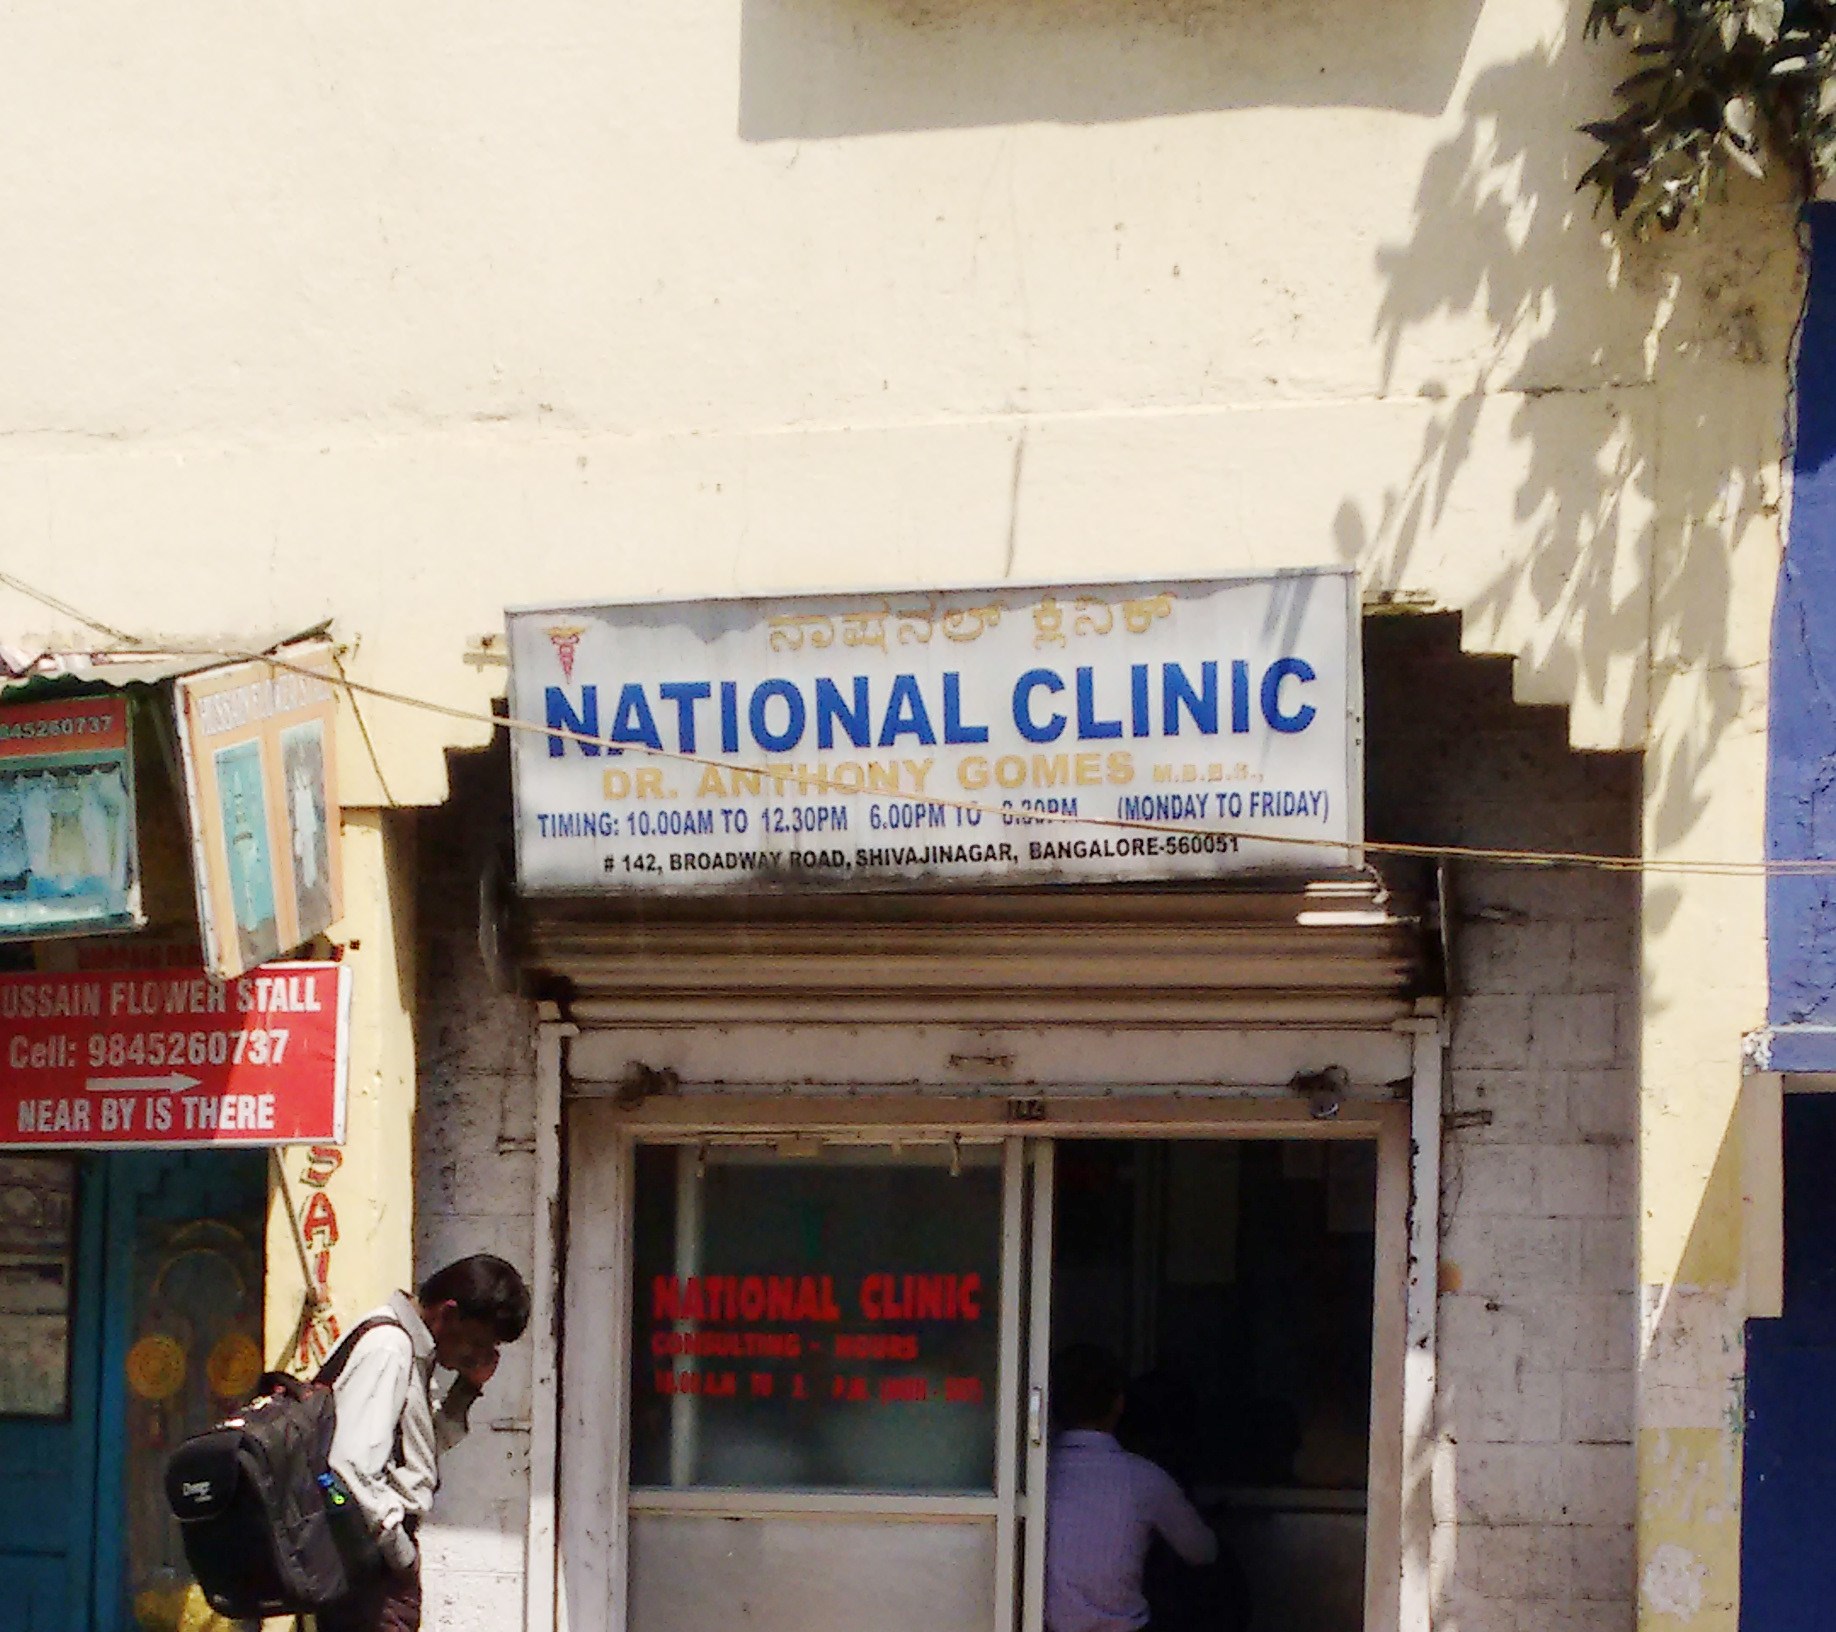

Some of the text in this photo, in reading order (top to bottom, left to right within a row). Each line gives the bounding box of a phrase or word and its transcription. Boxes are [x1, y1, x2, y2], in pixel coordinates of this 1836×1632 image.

[545, 656, 1318, 759] NATIONAL CLINIC
[602, 766, 679, 801] DR.
[698, 757, 936, 798] ANTHONY
[957, 751, 1136, 791] GOMES
[536, 810, 620, 838] TIMING:
[627, 808, 714, 837] 10.00AM
[720, 807, 749, 835] TO
[761, 804, 848, 833] 12.30PM
[869, 801, 947, 831] 6.00PM
[955, 799, 982, 828] TO
[1117, 791, 1207, 823] (MONDAY
[1216, 789, 1243, 818] TO
[1249, 788, 1330, 824] FRIDAY)
[622, 852, 664, 875] 142,
[669, 849, 783, 872] BROADWAY
[789, 847, 852, 871] ROAD,
[855, 842, 1020, 868] SHIVAJINAGAR,
[1028, 836, 1241, 861] BANGALORE-560051
[109, 977, 227, 1016] FLOWER
[236, 976, 322, 1014] STALL
[8, 1028, 290, 1070] Cell: 9845260737
[17, 1093, 276, 1133] NEAR BY IS THERE
[651, 1272, 982, 1322] NATIONAL CLINIC
